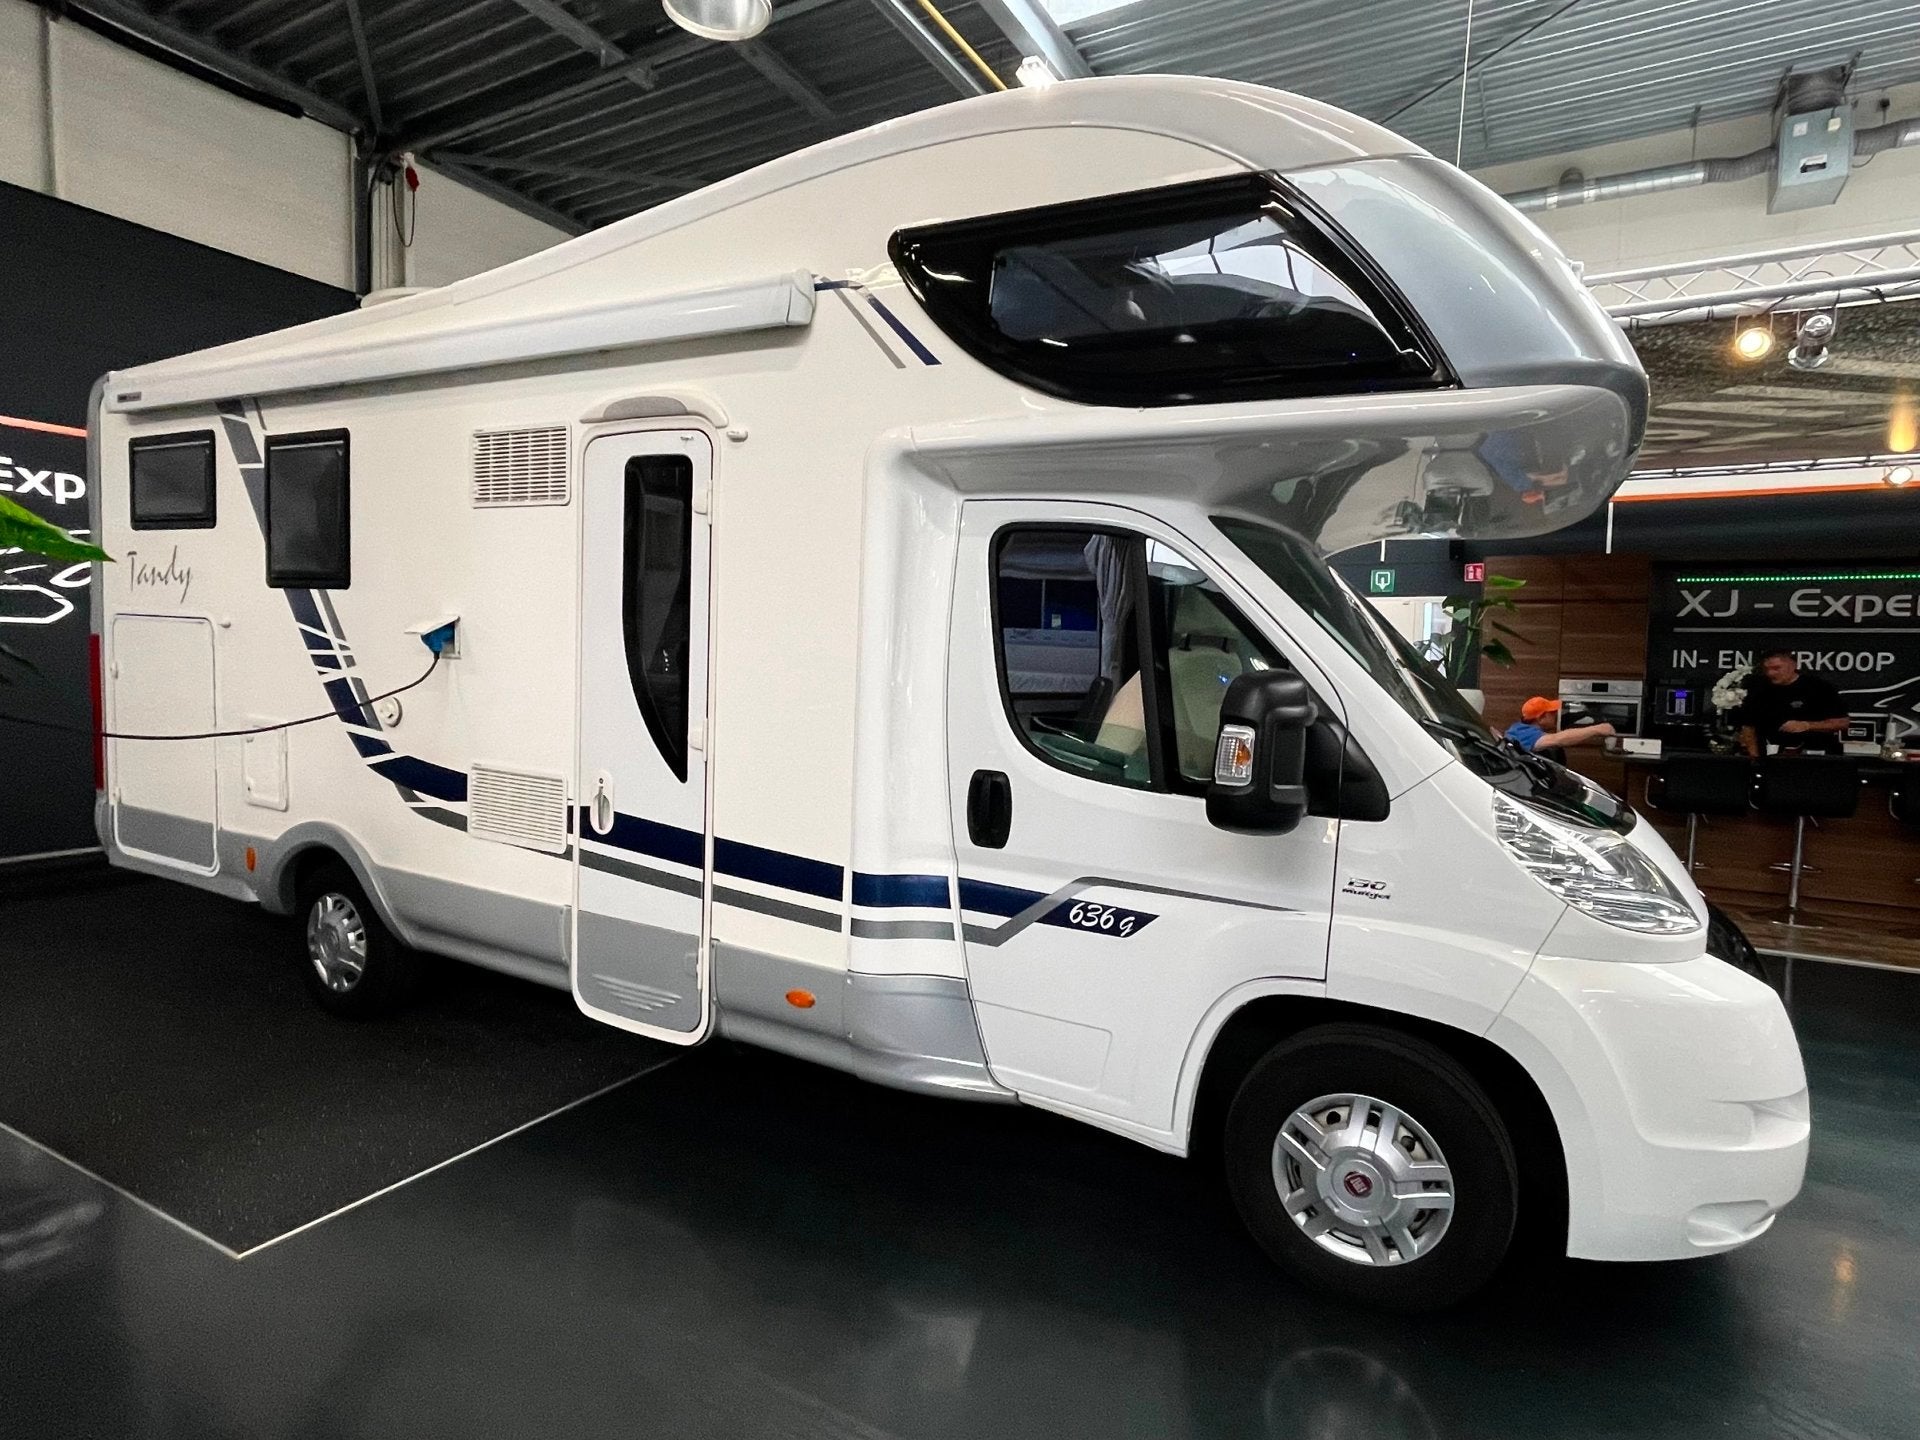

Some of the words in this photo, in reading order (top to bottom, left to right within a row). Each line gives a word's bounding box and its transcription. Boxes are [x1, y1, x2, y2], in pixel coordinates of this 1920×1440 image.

[127, 545, 191, 604] Tandy
[1676, 589, 1739, 617] XJ
[1789, 588, 1920, 623] Expe
[1672, 649, 1709, 668] IN-
[1718, 650, 1753, 669] EN
[1791, 650, 1895, 672] RKOOP
[1069, 902, 1117, 930] 636
